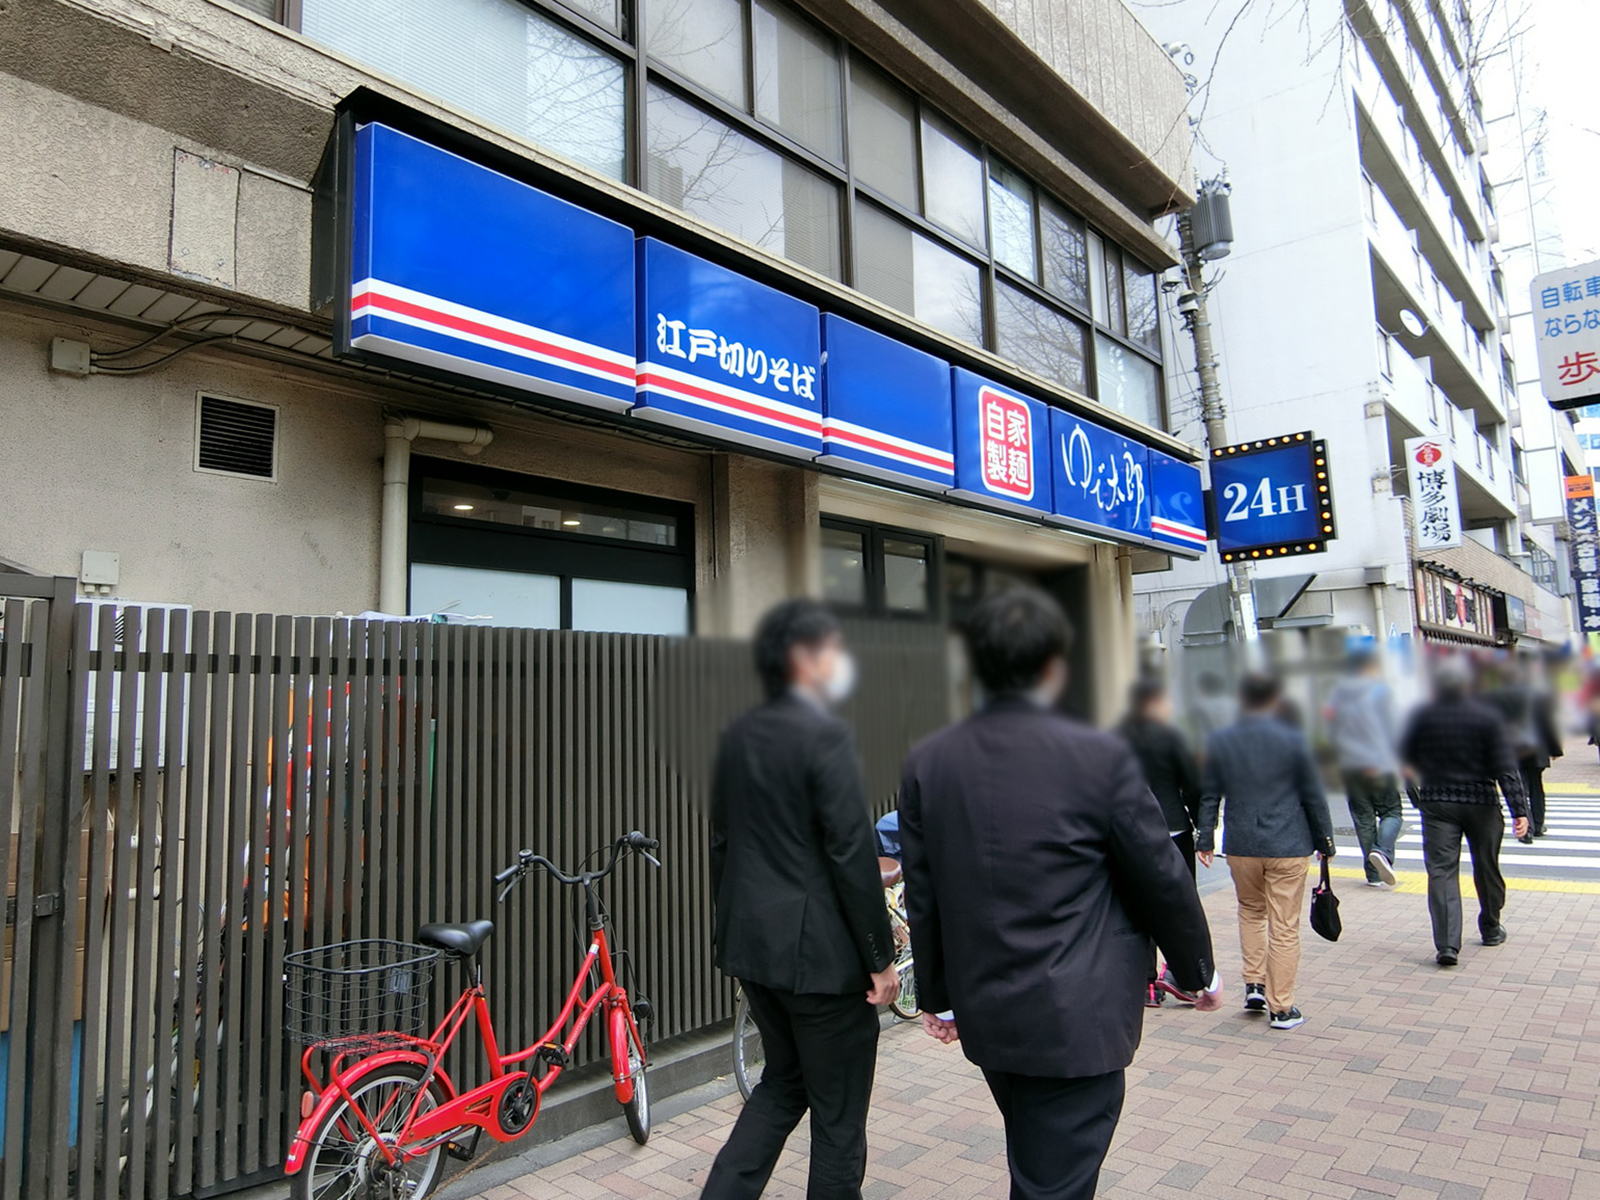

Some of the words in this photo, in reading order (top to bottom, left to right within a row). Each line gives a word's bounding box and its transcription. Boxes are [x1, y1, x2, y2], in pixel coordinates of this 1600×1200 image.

[1545, 309, 1600, 338] ならな
[656, 312, 816, 401] 江戸切りそば
[986, 400, 1028, 448] 自家
[986, 438, 1030, 489] 製麺
[1061, 423, 1145, 529] ゆで太郎
[1223, 477, 1308, 522] 24H
[1416, 468, 1453, 545] 博多劇場
